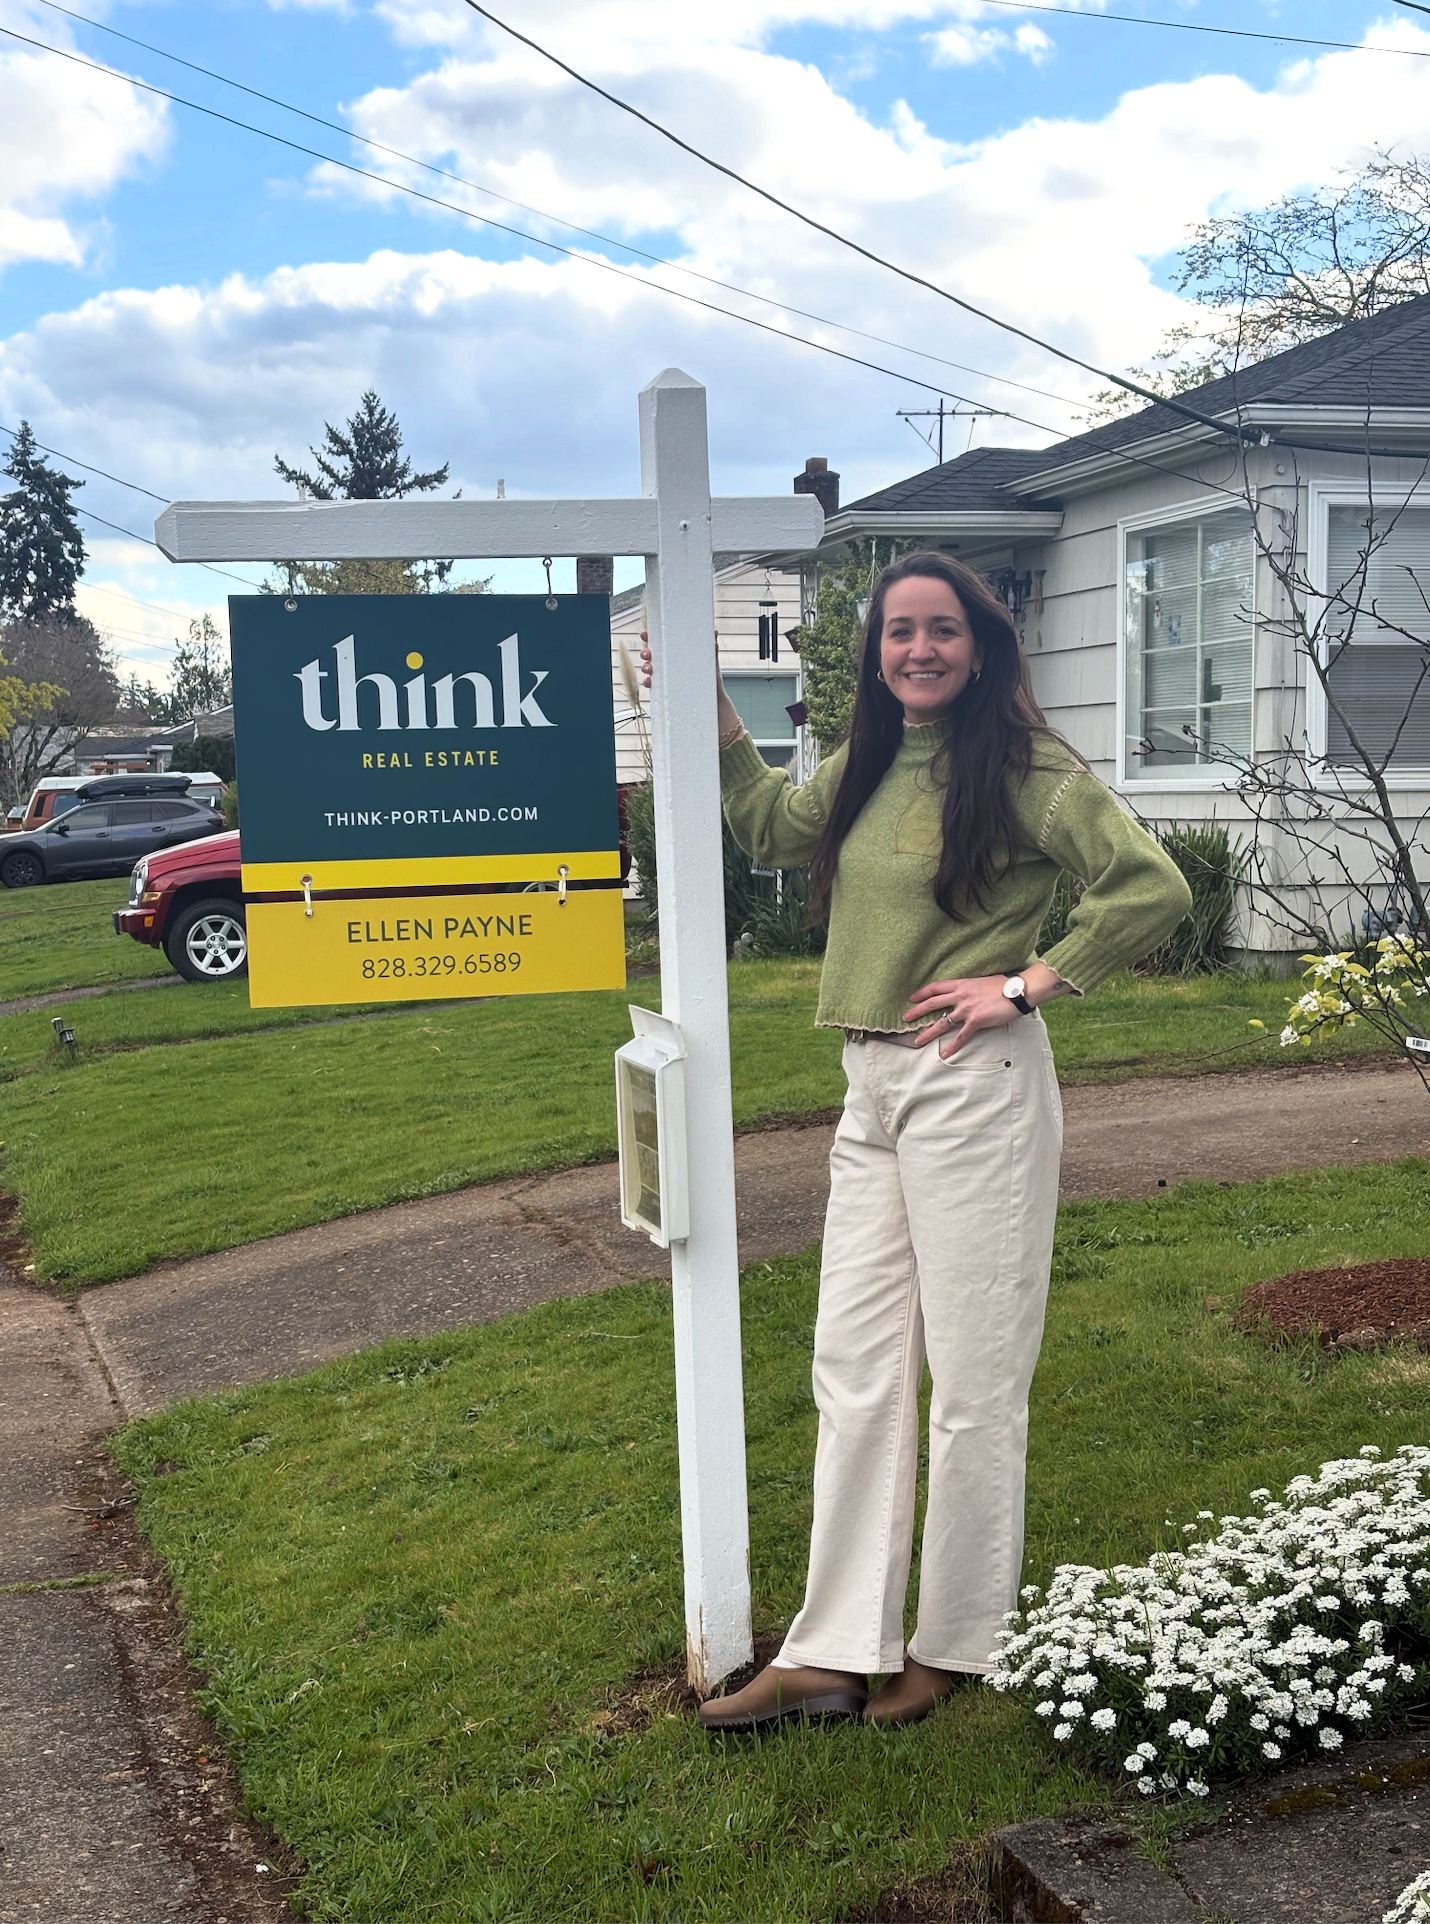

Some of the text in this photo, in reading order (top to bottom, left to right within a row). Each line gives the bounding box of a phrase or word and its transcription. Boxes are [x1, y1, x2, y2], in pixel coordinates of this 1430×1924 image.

[292, 631, 558, 732] think
[361, 750, 499, 769] REAL ESTATE
[323, 805, 538, 828] THINK-PORTLAND.COM
[347, 914, 533, 943] ELLEN PAYNE
[362, 951, 522, 979] 828.329.6589
